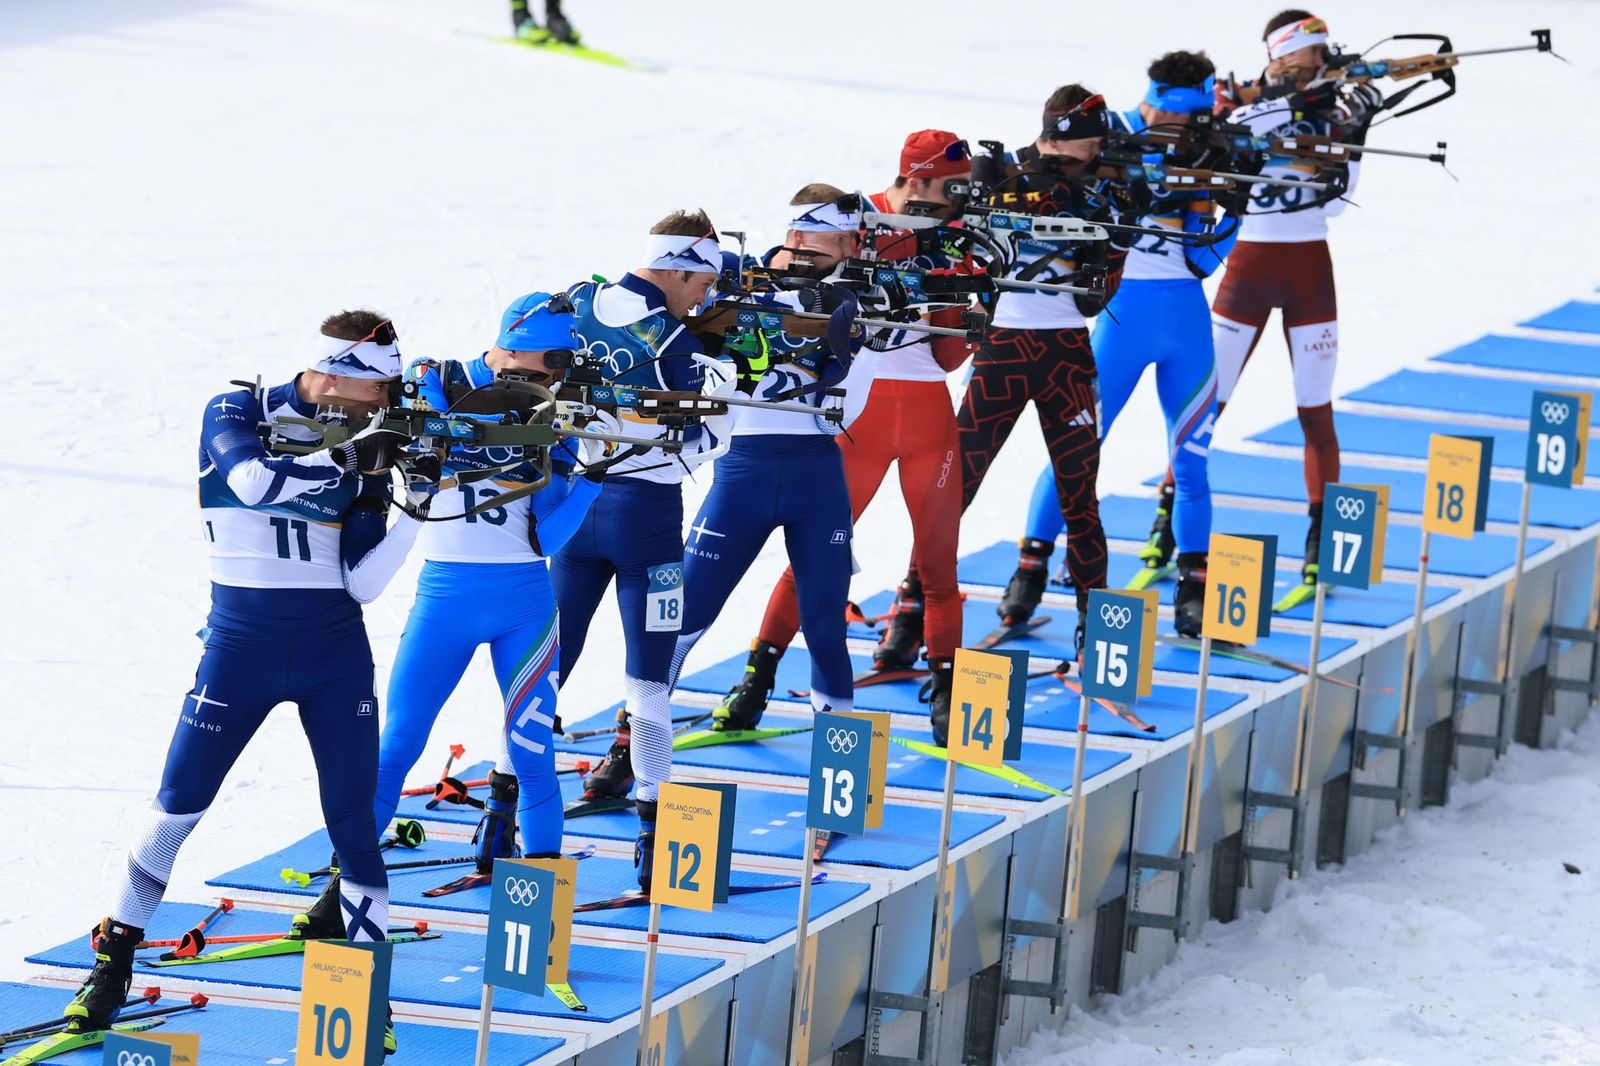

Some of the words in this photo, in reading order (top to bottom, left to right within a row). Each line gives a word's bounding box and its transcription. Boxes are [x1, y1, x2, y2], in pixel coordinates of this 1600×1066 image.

[1536, 432, 1567, 476] 19
[457, 483, 508, 526] 13
[1436, 481, 1465, 523] 18
[269, 515, 312, 562] 11
[1331, 529, 1363, 575] 17
[657, 598, 679, 620] 18
[1217, 583, 1247, 628] 16
[960, 667, 982, 677] MILANO
[982, 671, 1004, 682] CORTINA
[1095, 640, 1129, 688] 15
[181, 715, 222, 733] FINLAND
[961, 702, 994, 751] 14
[664, 802, 688, 813] MILANO
[688, 805, 713, 817] CORTINA
[822, 767, 855, 818] 13
[681, 812, 695, 821] 2026
[668, 840, 702, 893] 12
[311, 961, 337, 974] MILANO
[336, 966, 364, 978] CORTINA
[504, 920, 532, 976] 11
[313, 1003, 352, 1060] 10
